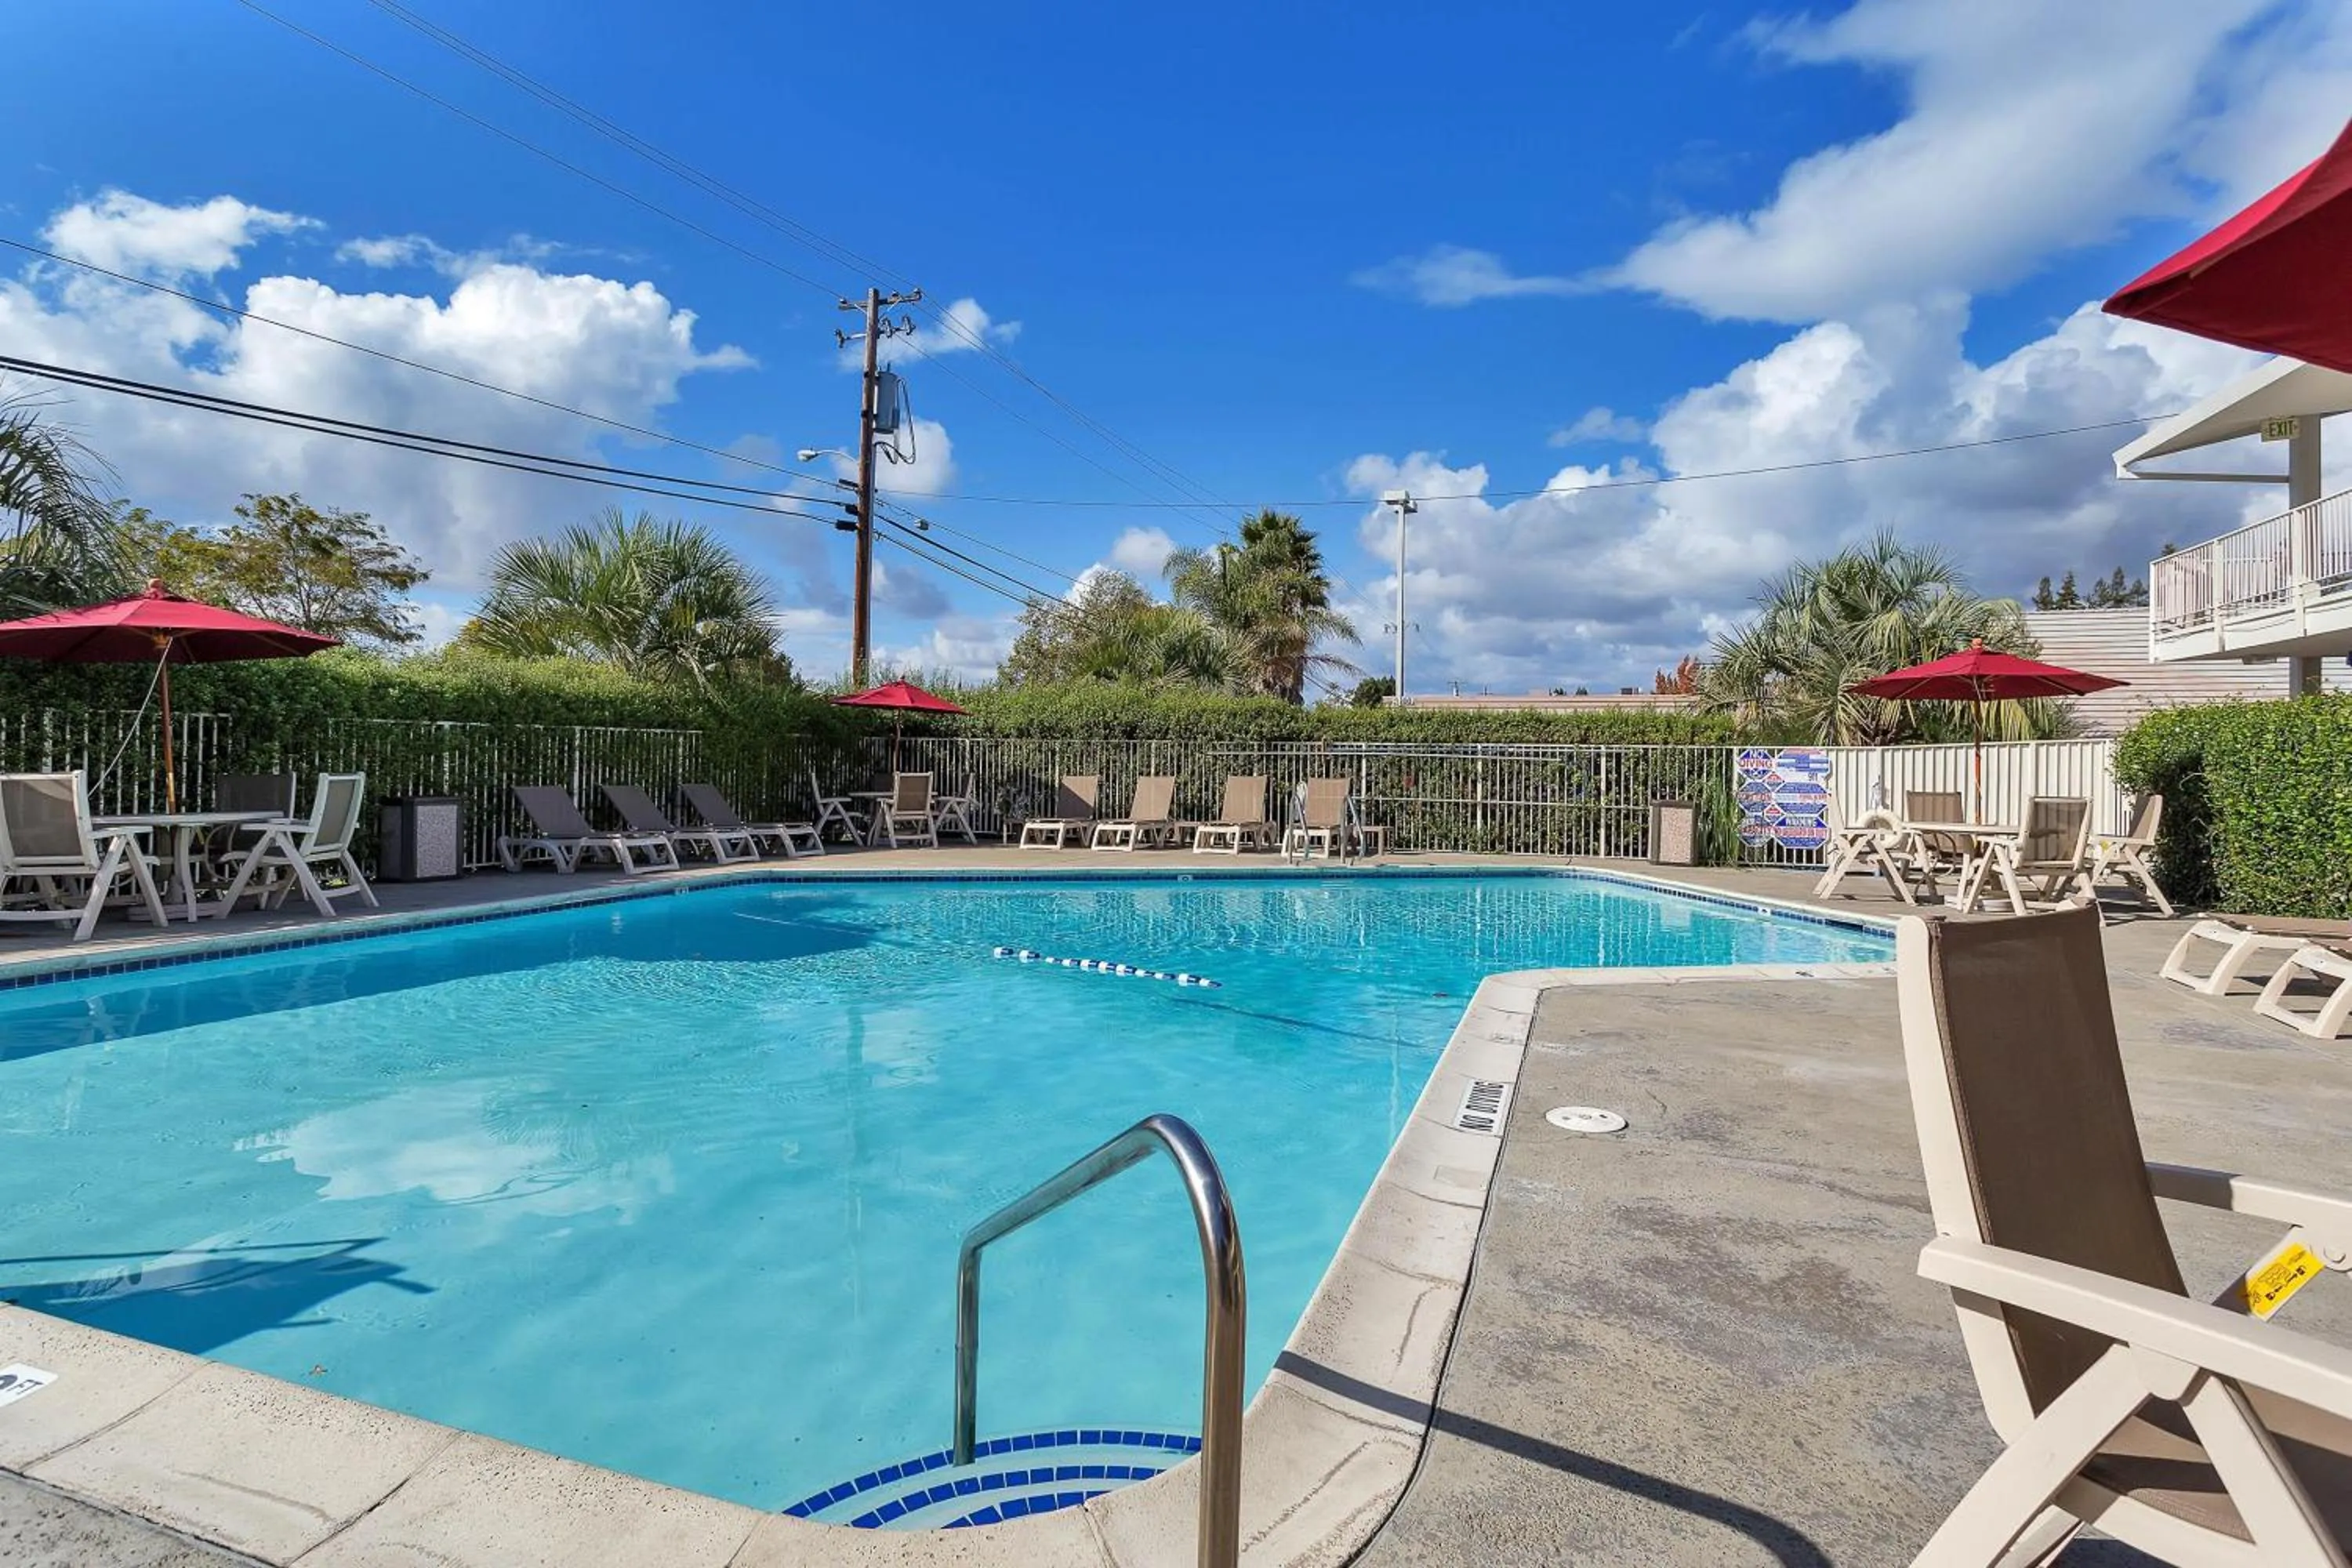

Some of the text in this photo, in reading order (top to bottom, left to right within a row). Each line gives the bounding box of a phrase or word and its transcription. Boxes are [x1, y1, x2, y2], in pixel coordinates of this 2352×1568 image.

[2268, 419, 2294, 437] EXIT
[1749, 749, 1763, 759] NO
[1739, 759, 1772, 768] DIVING
[1459, 1081, 1504, 1132] NO DIVING
[6, 1379, 44, 1395] FT
